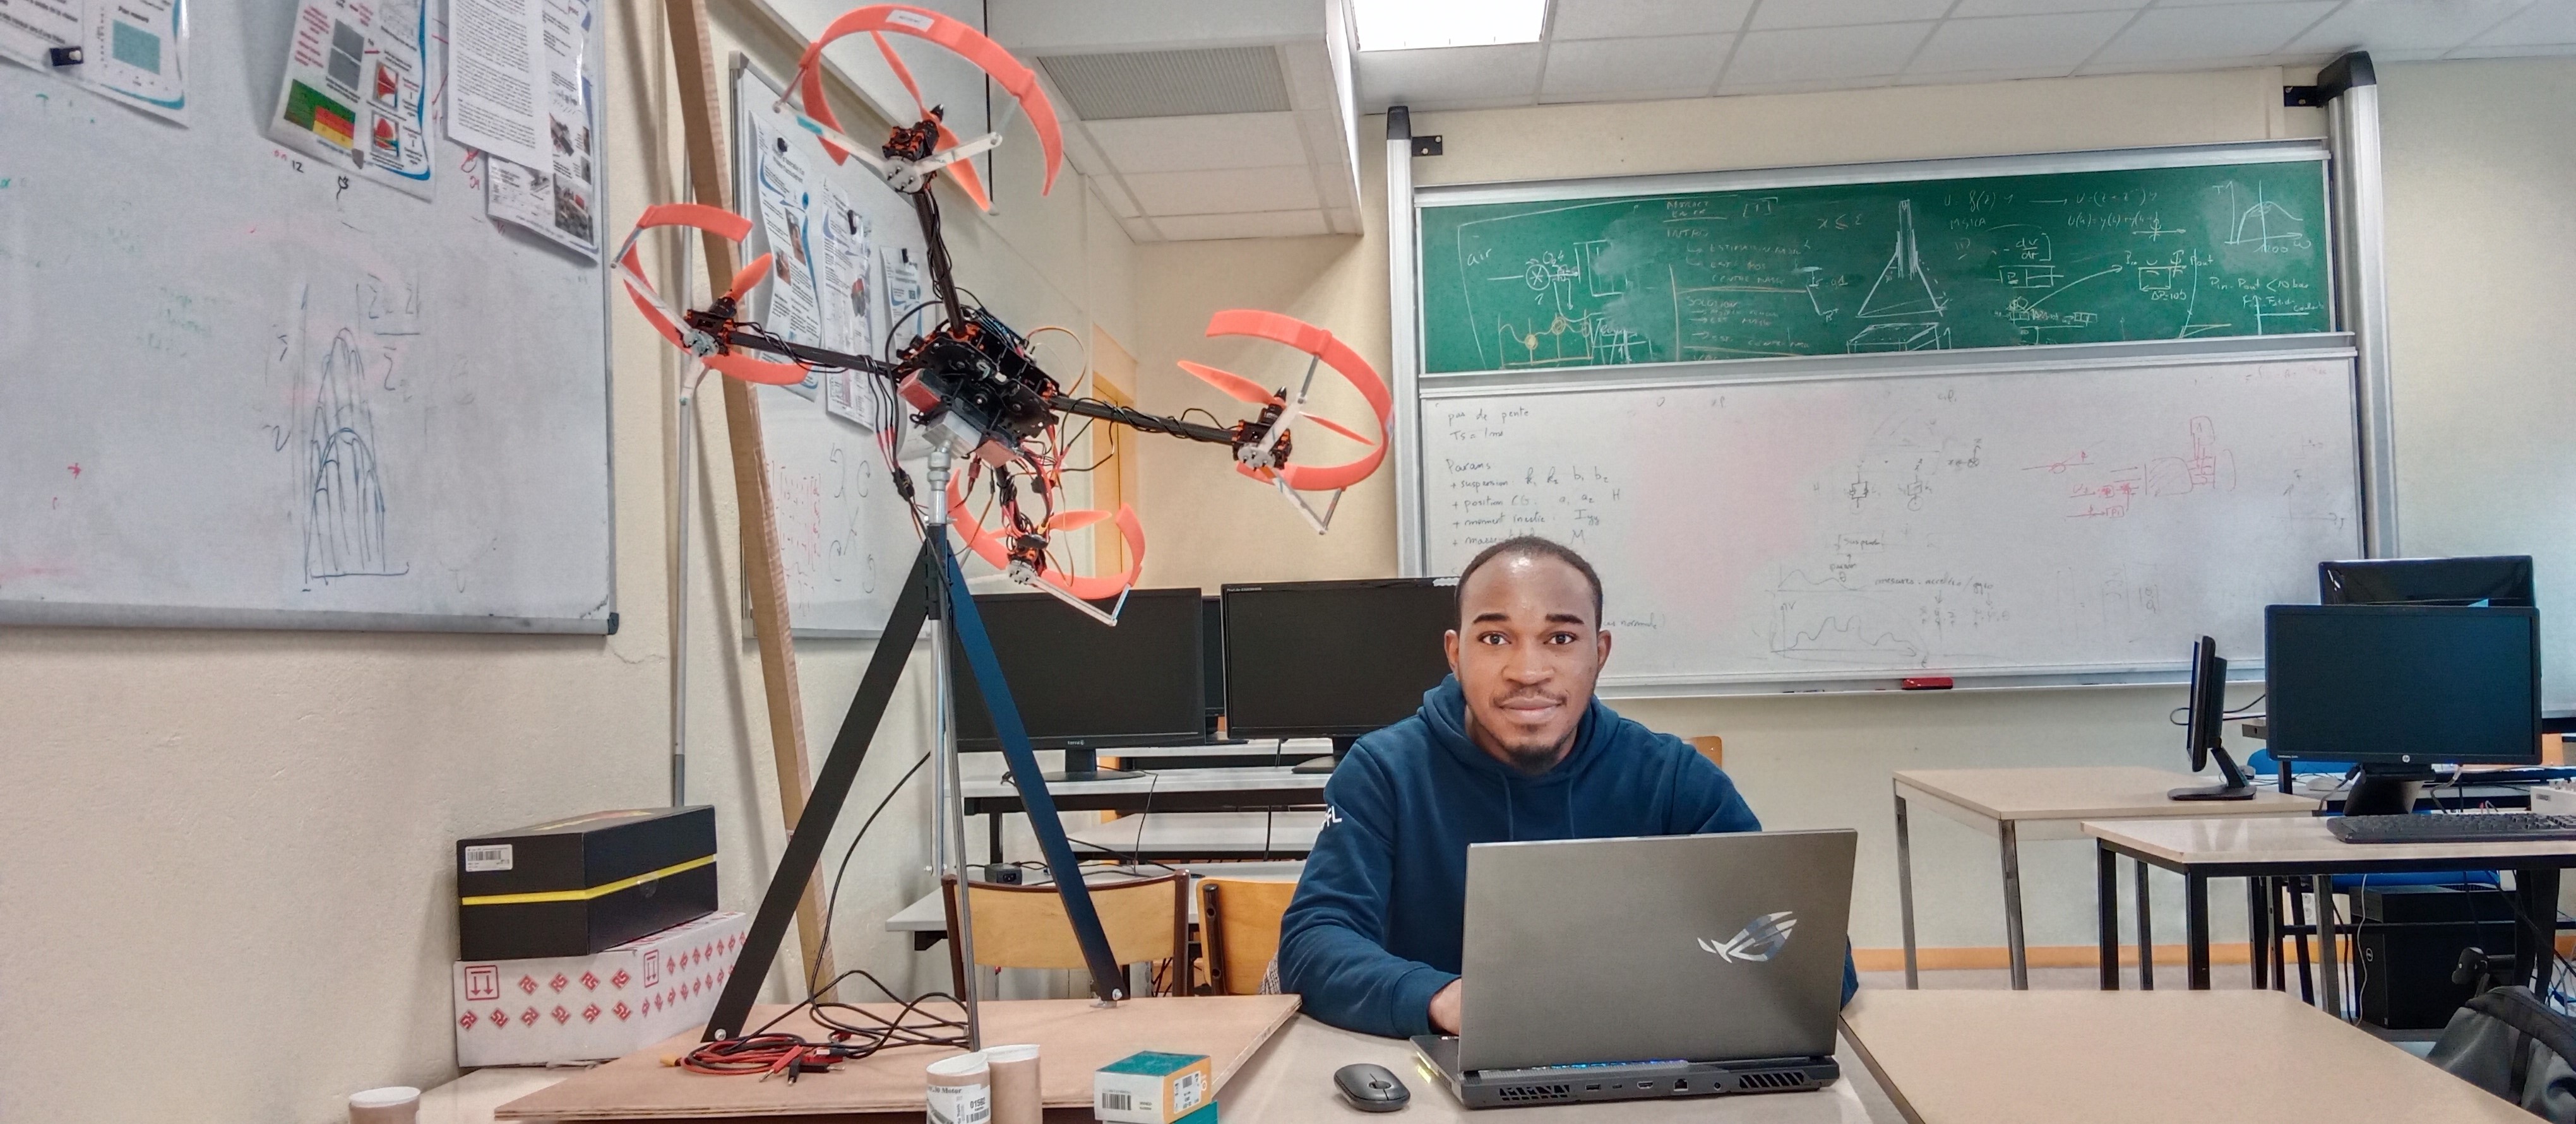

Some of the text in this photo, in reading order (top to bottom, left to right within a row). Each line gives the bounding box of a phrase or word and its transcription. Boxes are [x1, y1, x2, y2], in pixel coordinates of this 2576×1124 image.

[1467, 248, 1492, 266] air
[1448, 412, 1465, 426] pas
[1501, 406, 1529, 423] pente
[1445, 459, 1491, 474] Params
